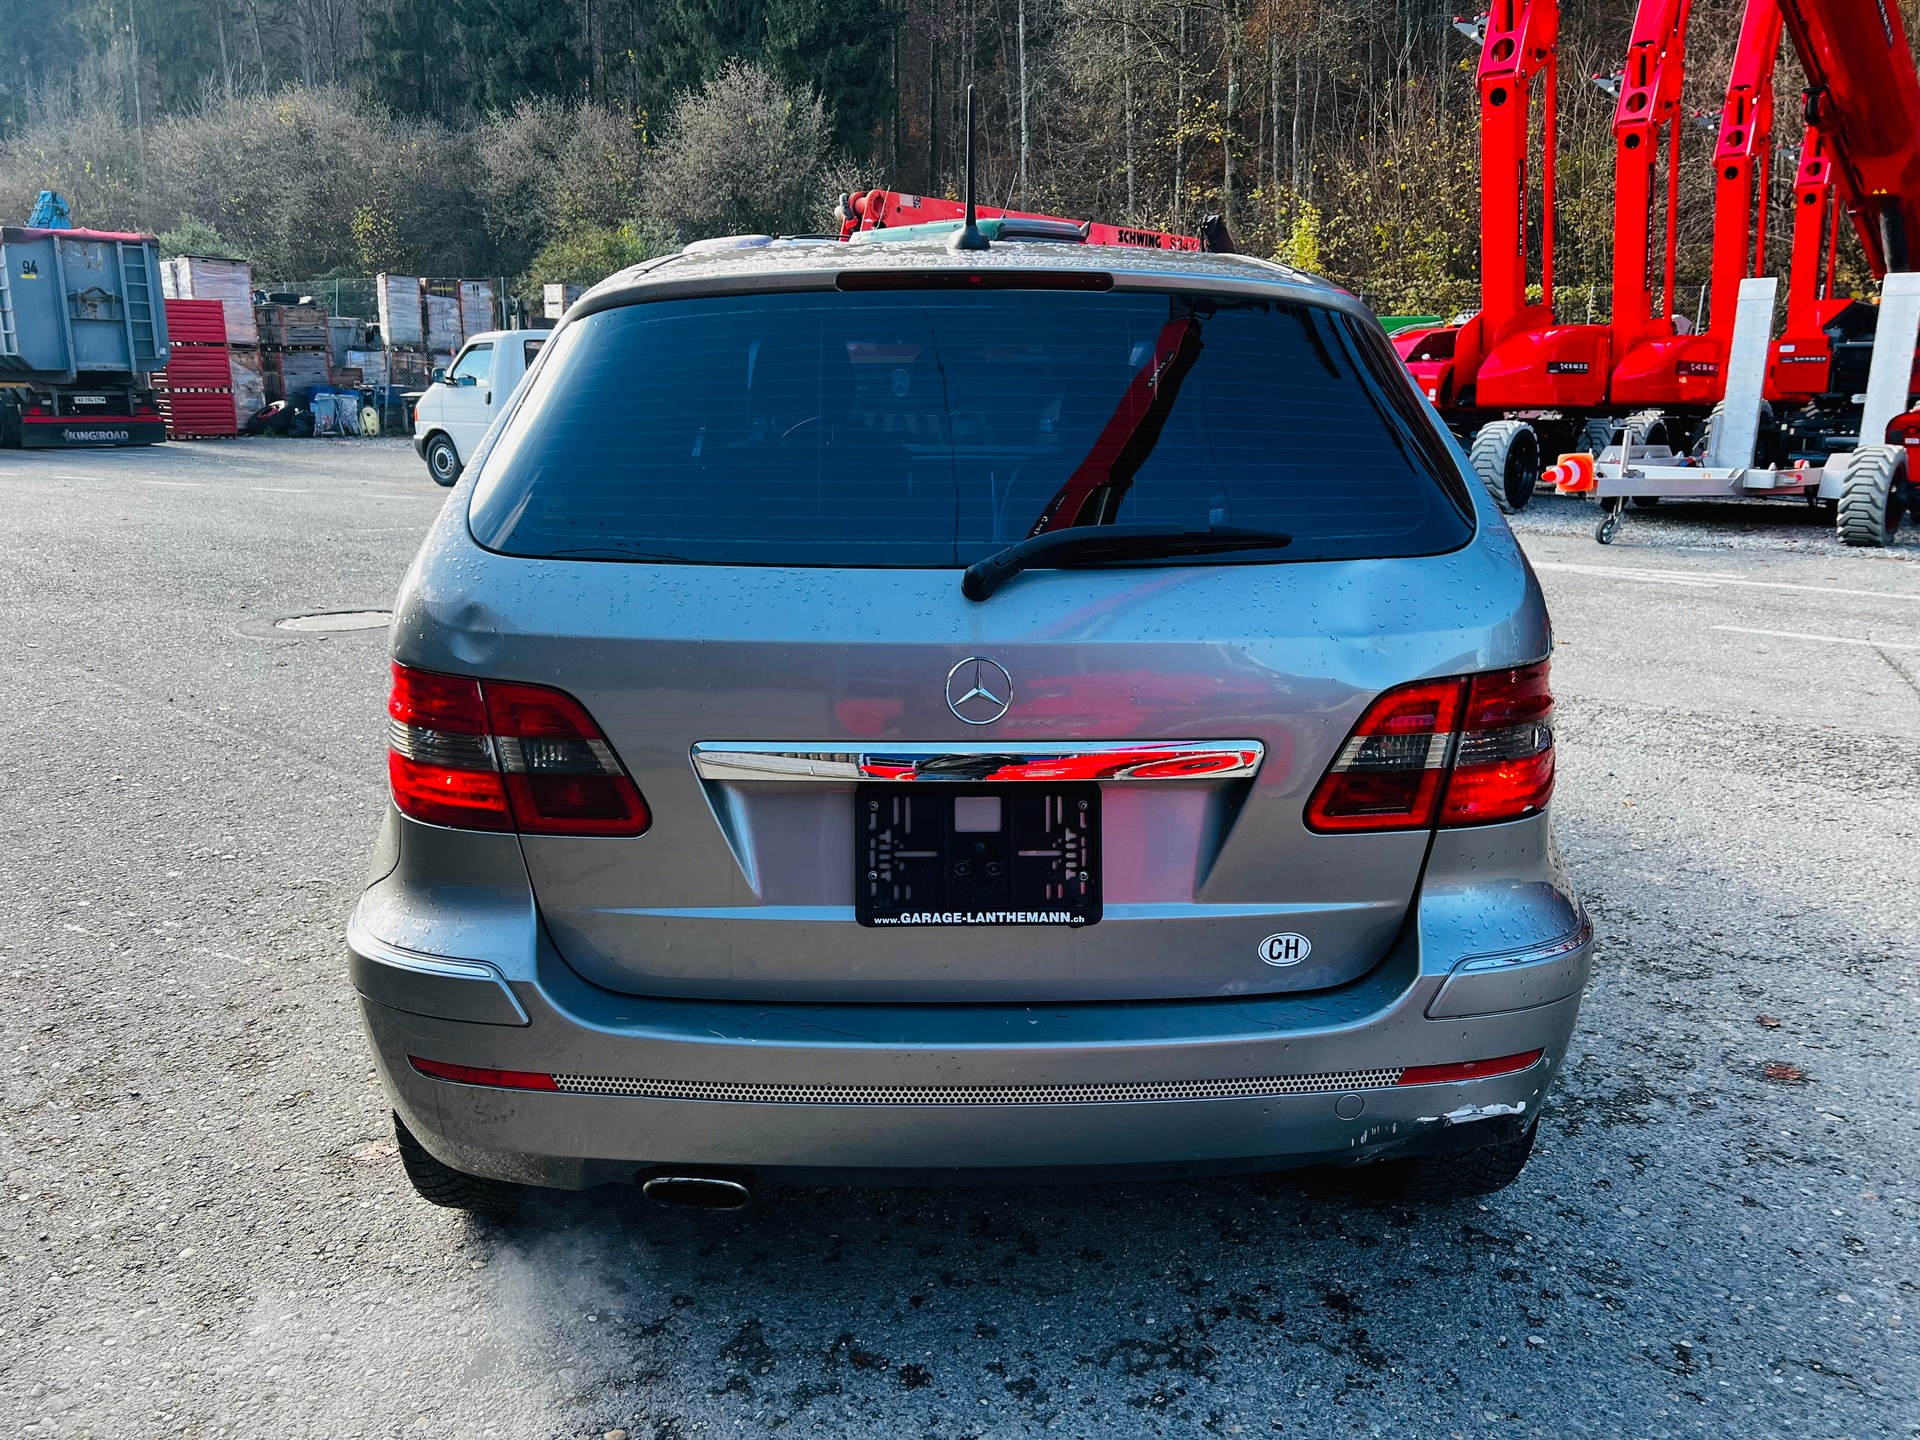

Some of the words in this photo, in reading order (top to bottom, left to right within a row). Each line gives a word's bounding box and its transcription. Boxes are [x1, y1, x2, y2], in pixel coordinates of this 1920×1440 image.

[1118, 230, 1162, 248] SCHWING
[22, 260, 38, 275] 94
[874, 912, 1085, 924] www.GARAGE-LANTHEMANN.ch
[1269, 938, 1299, 960] CH
